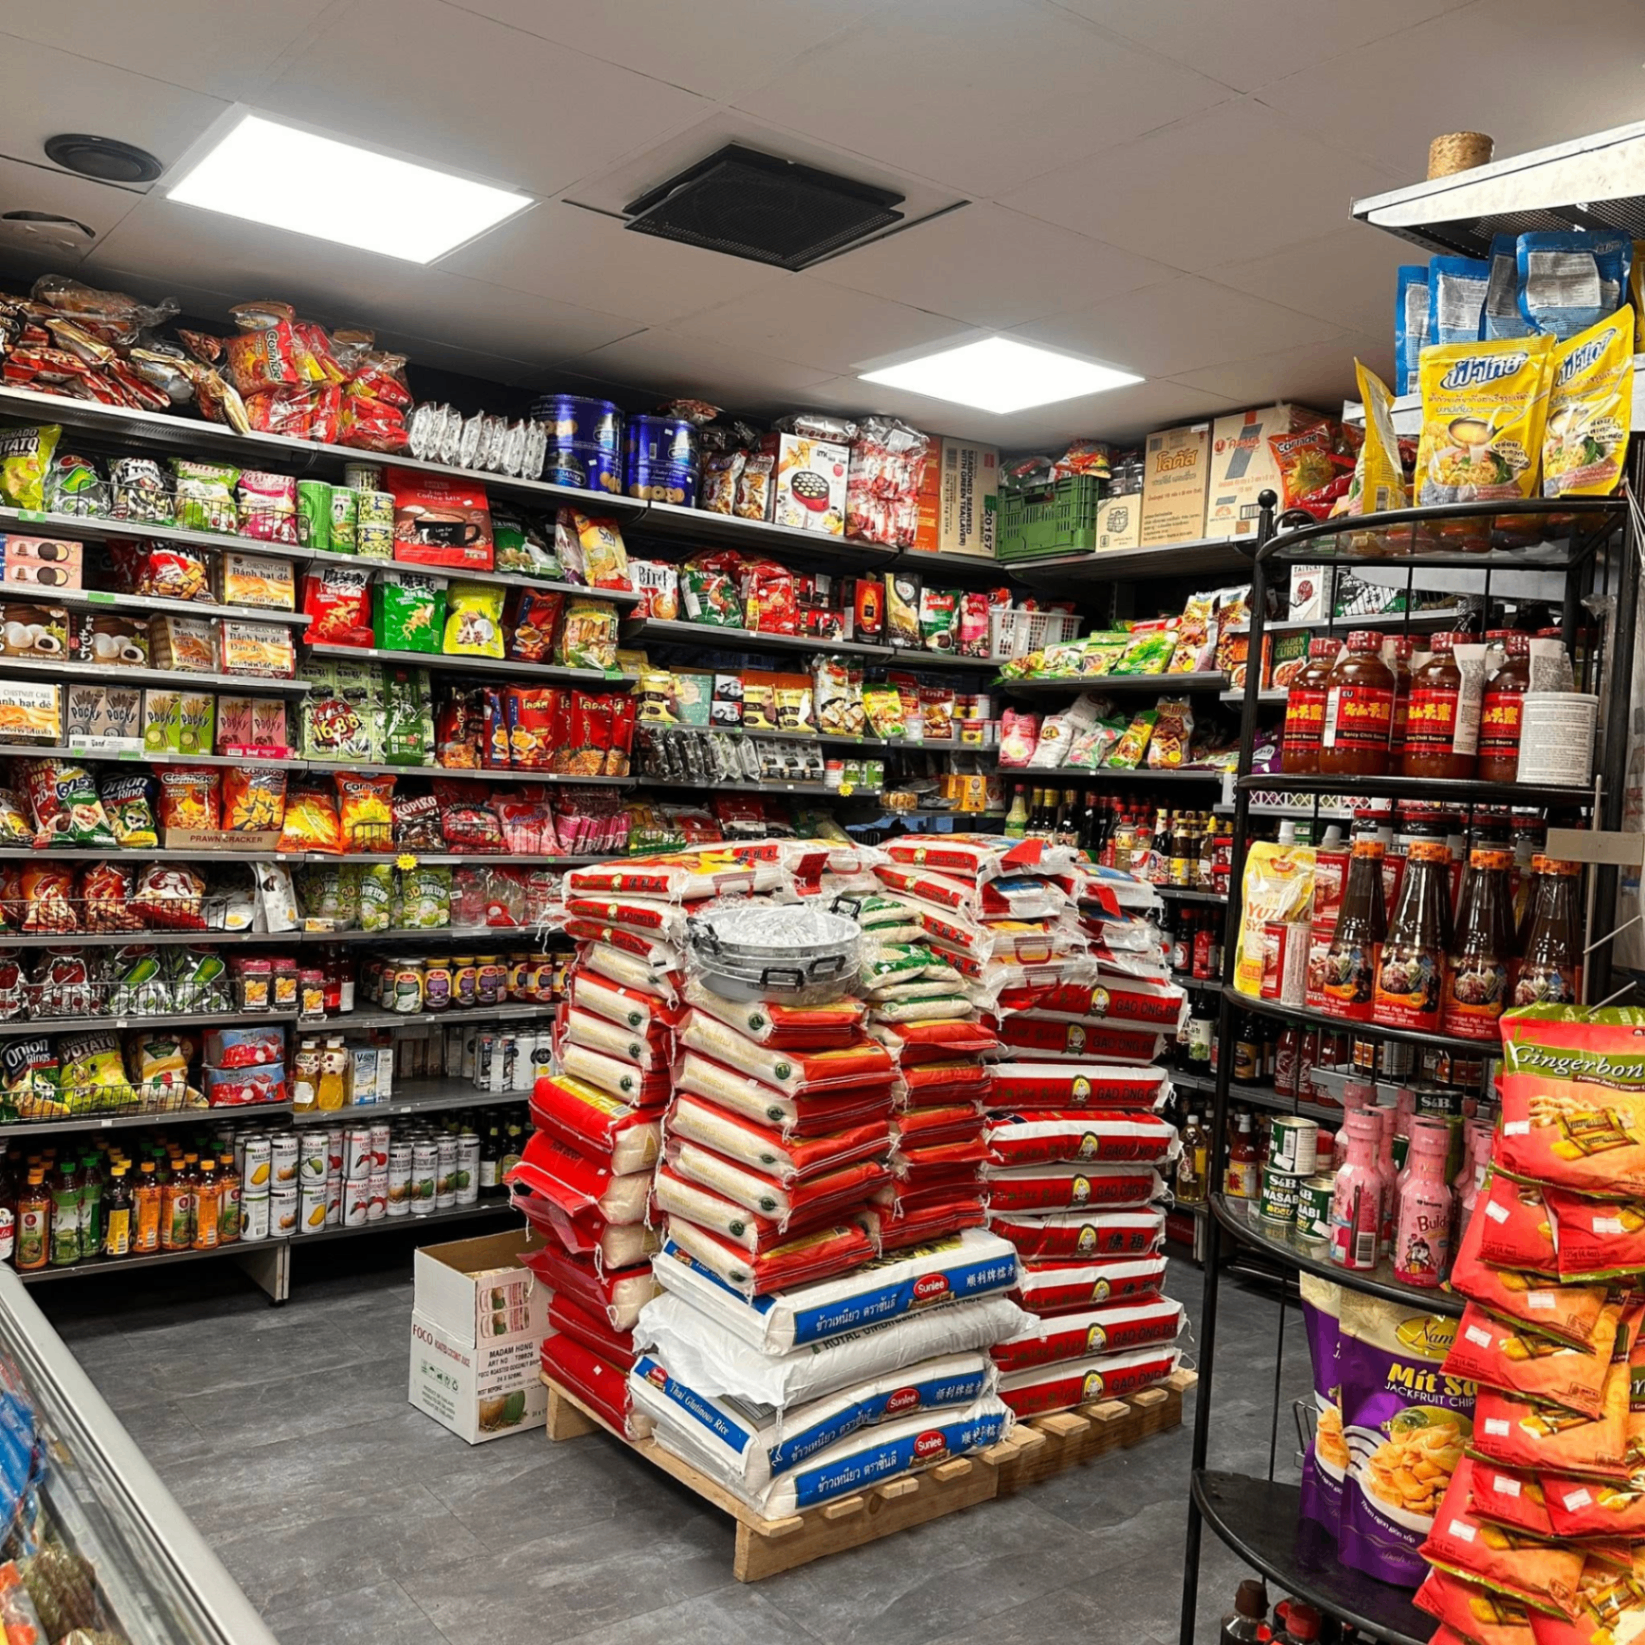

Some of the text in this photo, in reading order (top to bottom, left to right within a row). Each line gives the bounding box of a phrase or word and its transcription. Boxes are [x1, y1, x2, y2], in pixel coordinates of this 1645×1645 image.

[0, 428, 38, 440] ORNADO
[0, 437, 39, 452] TATO
[1275, 646, 1306, 659] CURRY
[71, 706, 102, 721] POCKY
[106, 709, 138, 723] POCKY
[147, 711, 178, 726] POCKY
[181, 714, 210, 728] POCKY
[102, 776, 148, 795] Onion
[190, 834, 221, 844] PRAWN
[6, 1038, 49, 1068] Onion
[26, 1051, 51, 1064] Rings
[62, 1036, 116, 1064] POTATO
[1514, 1044, 1645, 1079] Gingerbon
[1420, 1095, 1451, 1109] S&B
[1268, 1174, 1297, 1189] S&B
[1262, 1186, 1299, 1204] WASAB
[917, 1280, 945, 1295] Sunlee
[412, 1323, 433, 1346] FOCO
[489, 1346, 514, 1359] MADAM
[1387, 1362, 1438, 1393] Mít
[888, 1393, 918, 1410] Sunlee
[1384, 1381, 1476, 1408] JACKFRUIT CHIP
[669, 1381, 730, 1436] Thai Glutinous Rice
[917, 1436, 943, 1452] Sunlee
